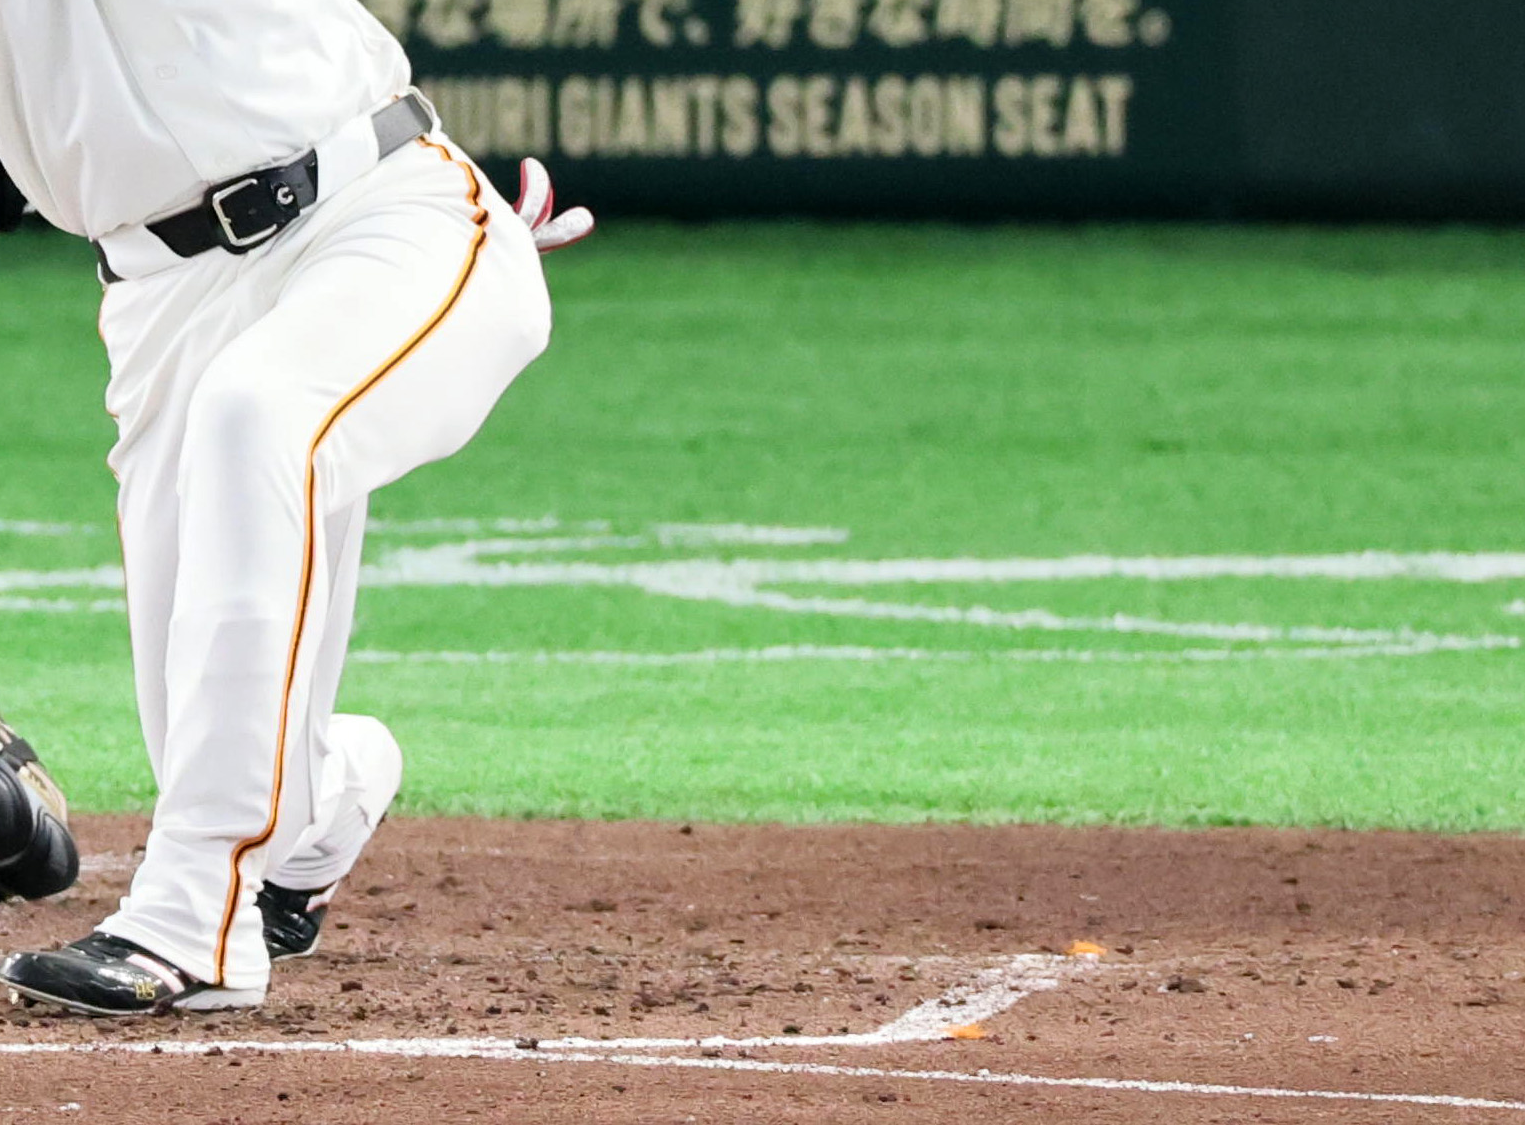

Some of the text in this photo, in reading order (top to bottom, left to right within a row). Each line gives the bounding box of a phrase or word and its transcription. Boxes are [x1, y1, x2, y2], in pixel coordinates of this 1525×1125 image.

[558, 77, 759, 158] GIANTS
[767, 75, 986, 157] SEASON
[992, 75, 1132, 157] SEAT
